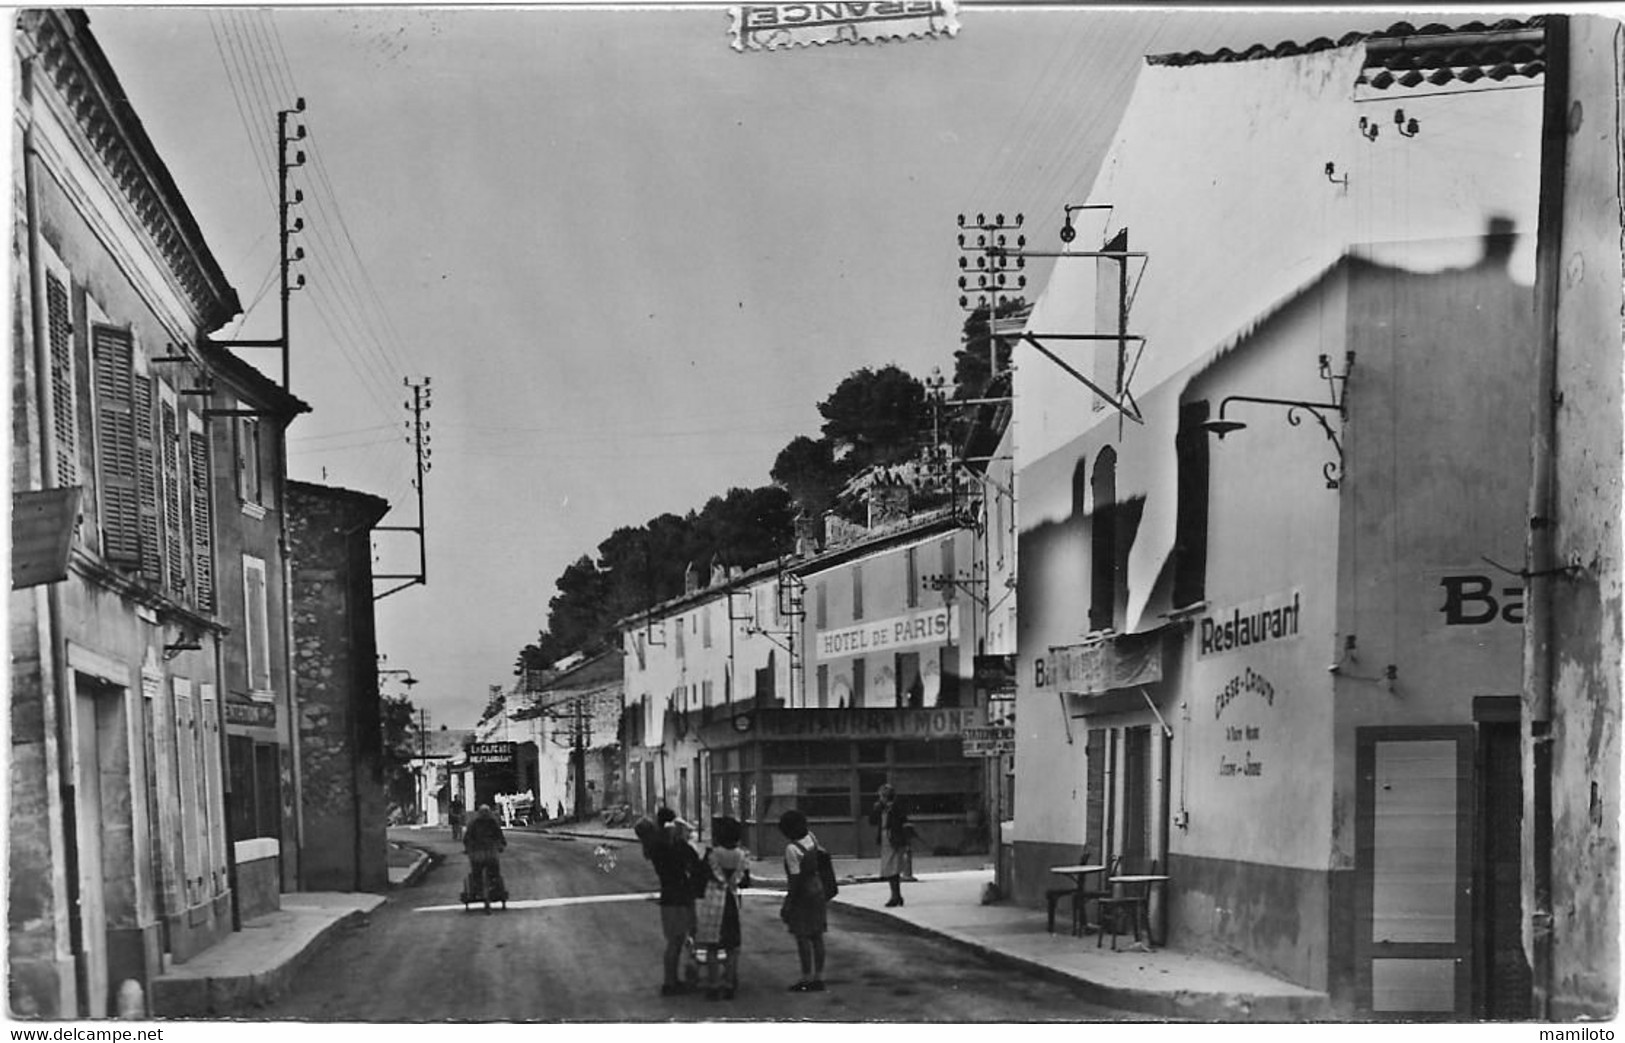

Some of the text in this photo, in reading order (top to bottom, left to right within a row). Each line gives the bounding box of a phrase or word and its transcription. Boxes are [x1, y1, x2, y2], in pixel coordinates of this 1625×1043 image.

[824, 613, 947, 653] HOTEL DE PARIS
[1201, 592, 1299, 655] Restaurant
